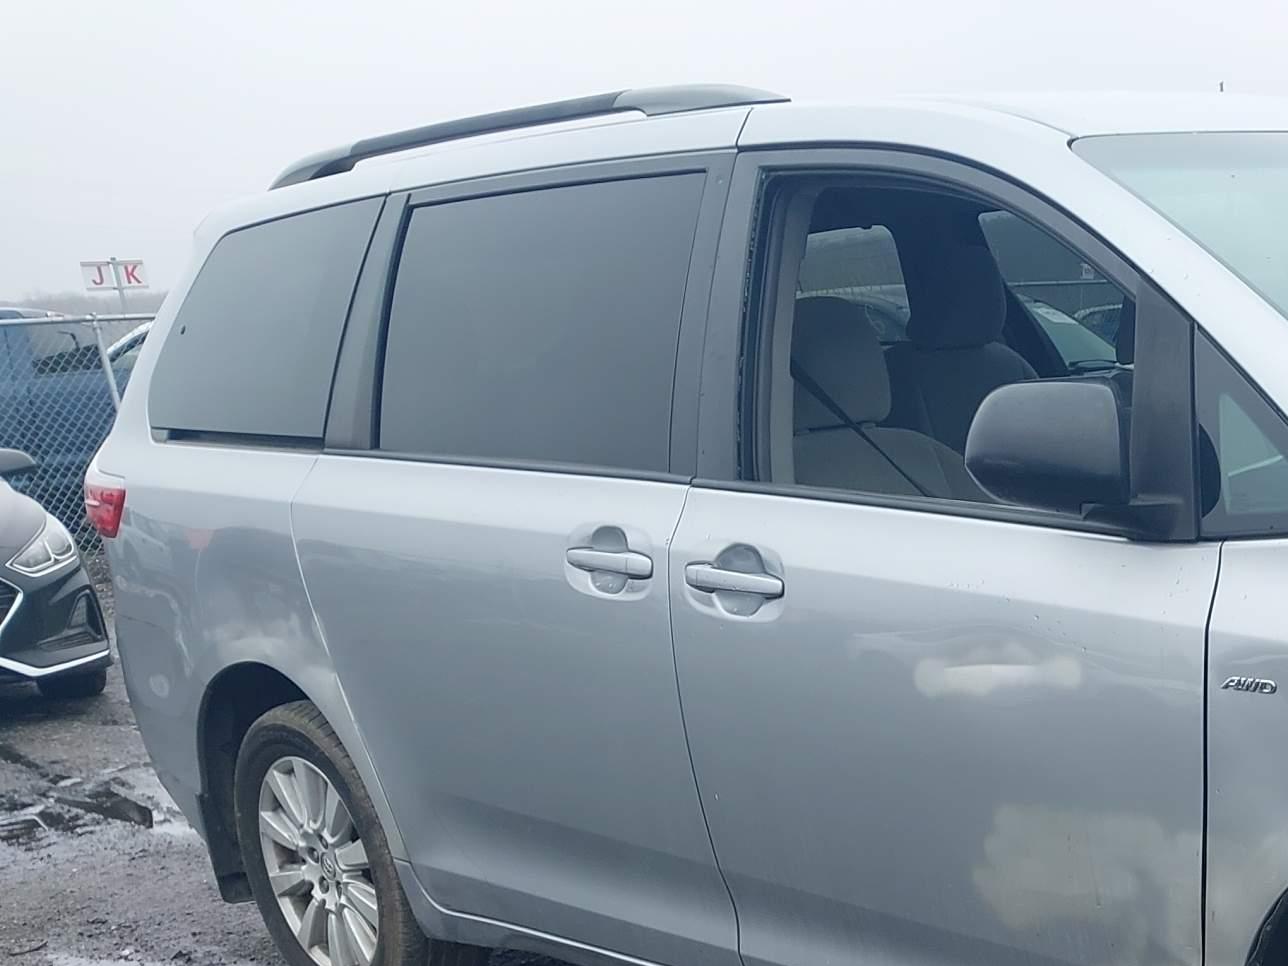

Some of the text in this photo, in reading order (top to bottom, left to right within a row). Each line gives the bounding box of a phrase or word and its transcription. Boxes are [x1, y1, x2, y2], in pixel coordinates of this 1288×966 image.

[91, 264, 105, 286] J
[123, 263, 143, 285] K
[1220, 676, 1278, 695] AWD
